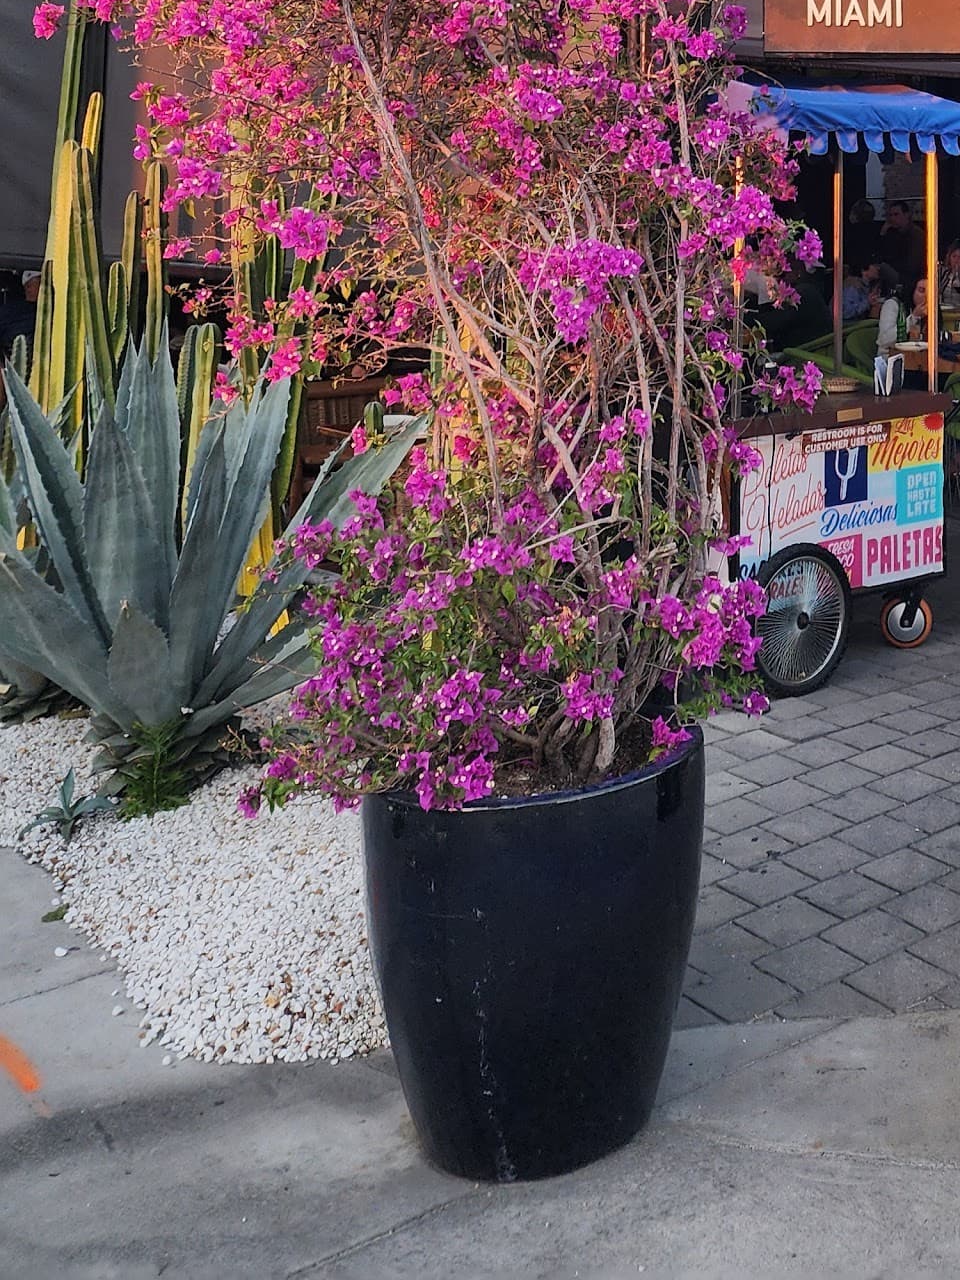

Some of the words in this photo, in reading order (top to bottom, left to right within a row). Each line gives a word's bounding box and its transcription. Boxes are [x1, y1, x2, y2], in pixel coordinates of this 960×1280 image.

[804, 439, 849, 453] CUSTOMER
[850, 436, 867, 447] USE
[867, 433, 888, 445] ONLY
[811, 427, 856, 442] RESTROOM
[857, 426, 866, 435] IS
[866, 424, 883, 434] FOR
[870, 435, 941, 471] Mejores
[907, 471, 937, 489] OPEN
[746, 473, 827, 556] Heladas
[820, 502, 898, 537] Deliciosas
[907, 499, 937, 518] LATE
[867, 525, 942, 577] PALETAS
